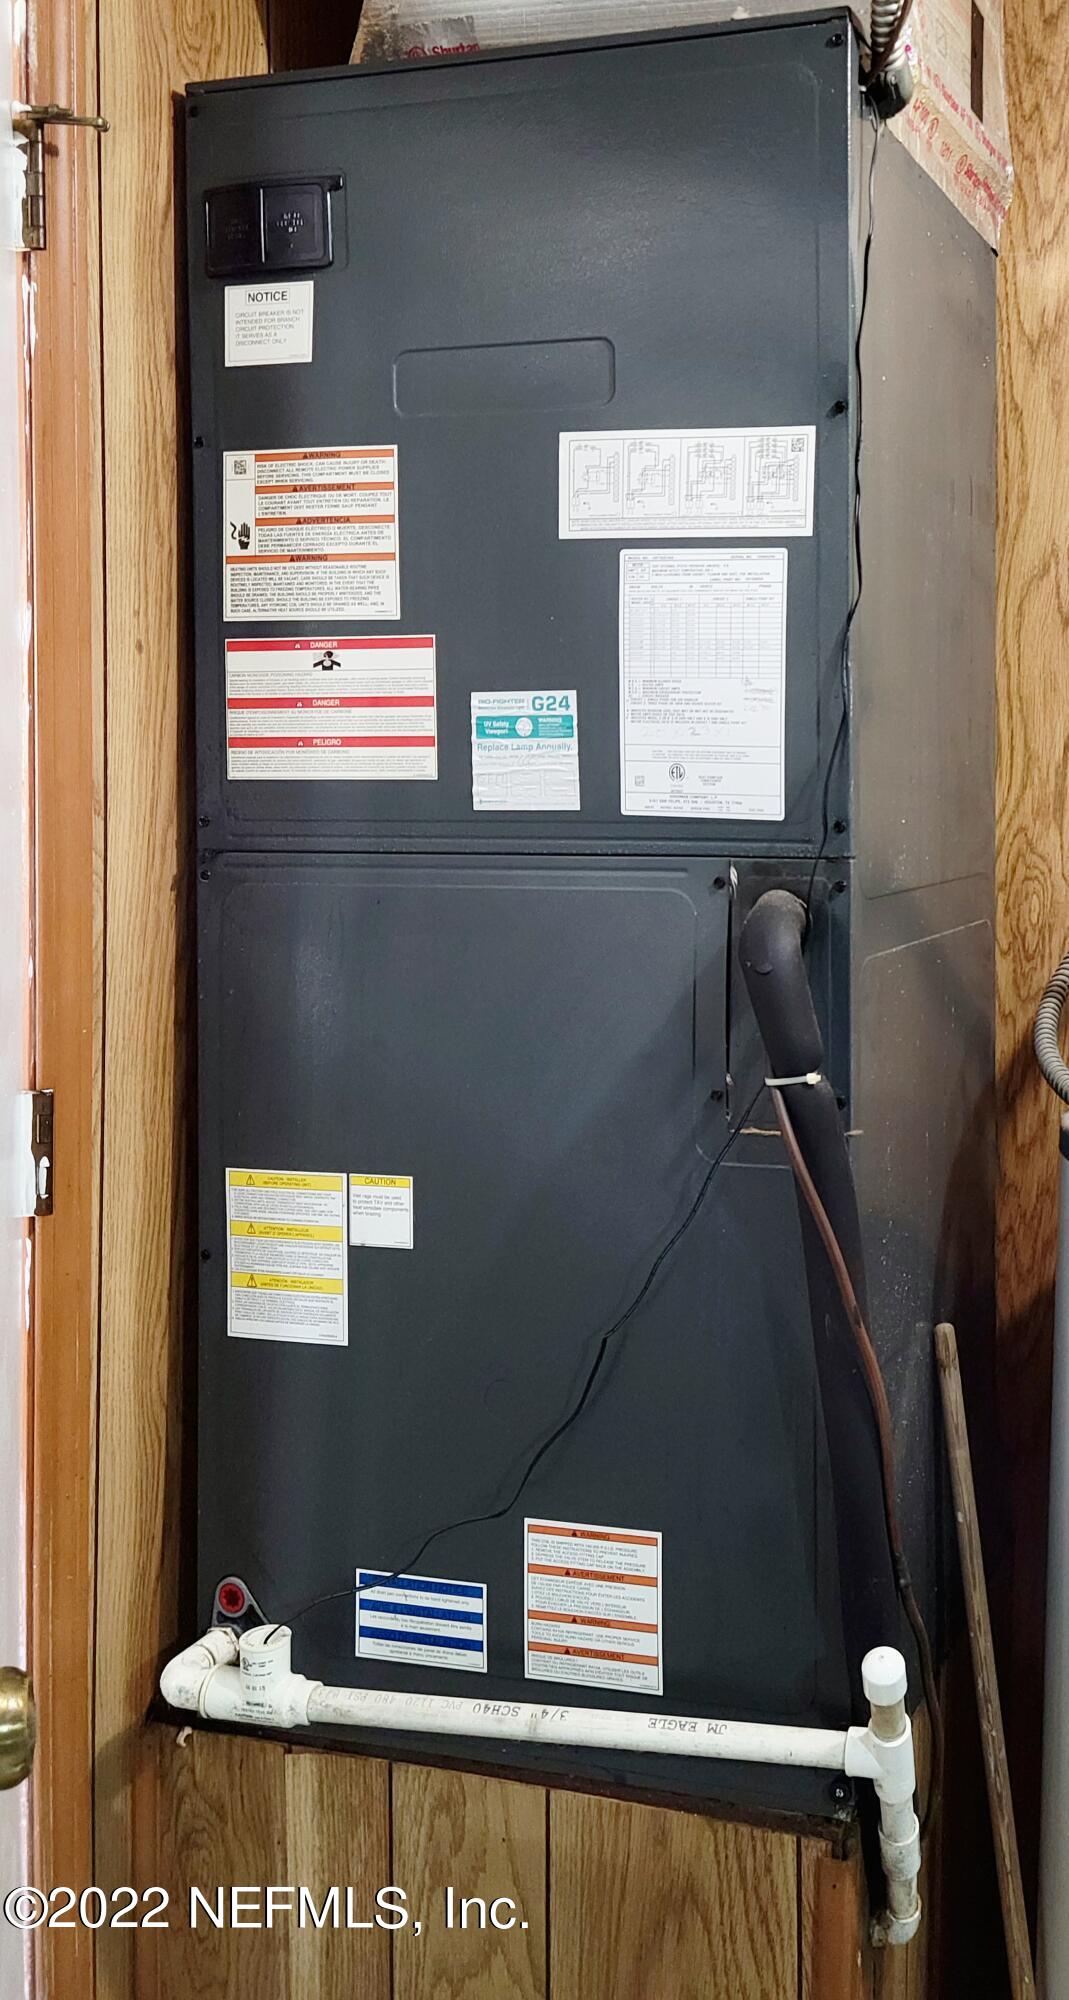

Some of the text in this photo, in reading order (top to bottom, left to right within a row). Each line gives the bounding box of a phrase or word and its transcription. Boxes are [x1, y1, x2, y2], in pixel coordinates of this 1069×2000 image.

[247, 290, 288, 303] NOTICE
[308, 451, 341, 459] WARNING
[294, 554, 328, 562] WARNING
[531, 695, 570, 711] G24
[312, 738, 342, 746] PELIGRO
[477, 743, 509, 752] Replace
[511, 744, 533, 752] Lamp
[364, 1177, 396, 1186] CAUTION
[580, 1531, 610, 1541] WARNING
[580, 1617, 610, 1627] WARNING
[472, 1702, 521, 1717] SCH40
[647, 1717, 698, 1732] EAGLE
[706, 1724, 728, 1735] JM
